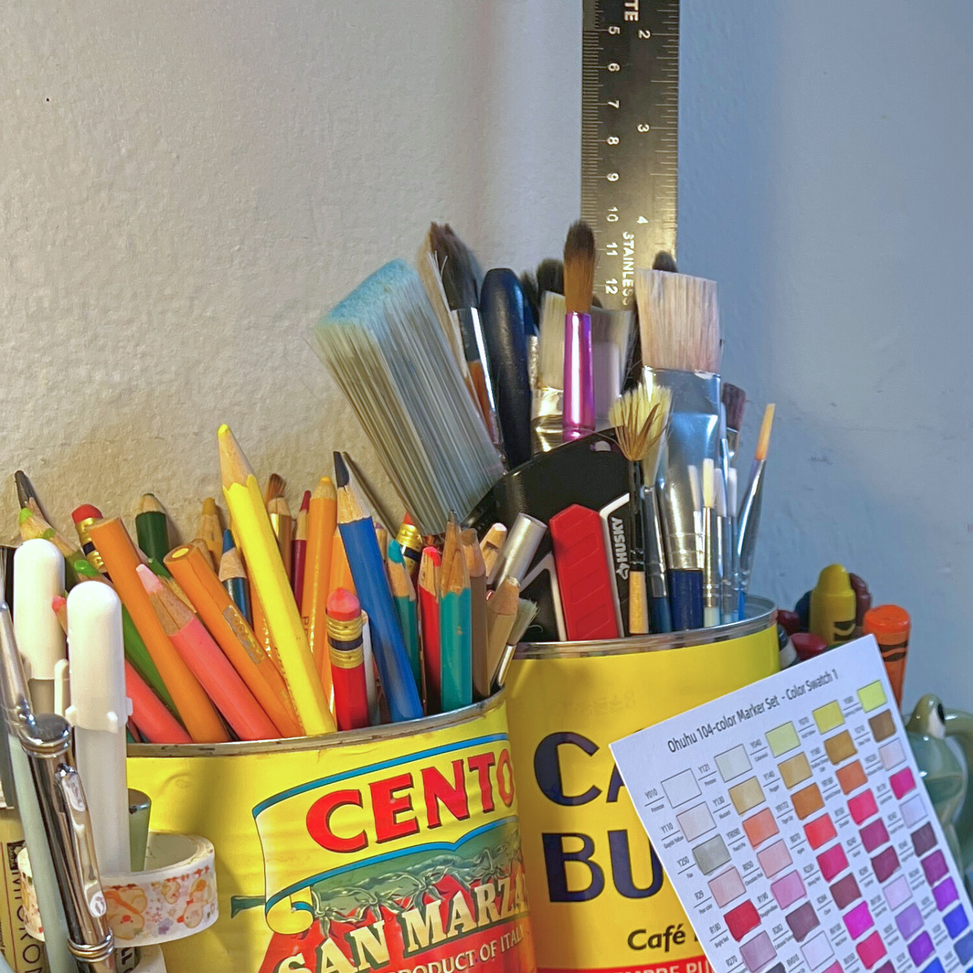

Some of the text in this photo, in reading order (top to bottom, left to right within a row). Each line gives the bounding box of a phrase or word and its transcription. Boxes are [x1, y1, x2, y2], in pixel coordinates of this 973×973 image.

[608, 26, 620, 34] 5
[639, 30, 651, 39] 2
[608, 63, 620, 72] 6
[608, 100, 620, 109] 7
[638, 123, 650, 132] 3
[607, 136, 620, 145] 8
[606, 172, 619, 182] 9
[606, 206, 619, 222] 10
[637, 215, 649, 224] 4
[606, 242, 619, 256] 11
[605, 279, 618, 295] 12
[611, 517, 628, 563] HUSKY
[665, 729, 699, 753] Ohuhu
[695, 712, 737, 740] 104-color
[734, 699, 767, 723] Marker
[763, 693, 780, 710] Set
[784, 681, 807, 701] Color
[804, 670, 833, 692] Swatch
[306, 749, 515, 854] CENTO
[628, 924, 686, 952] Café
[480, 939, 498, 962] OF
